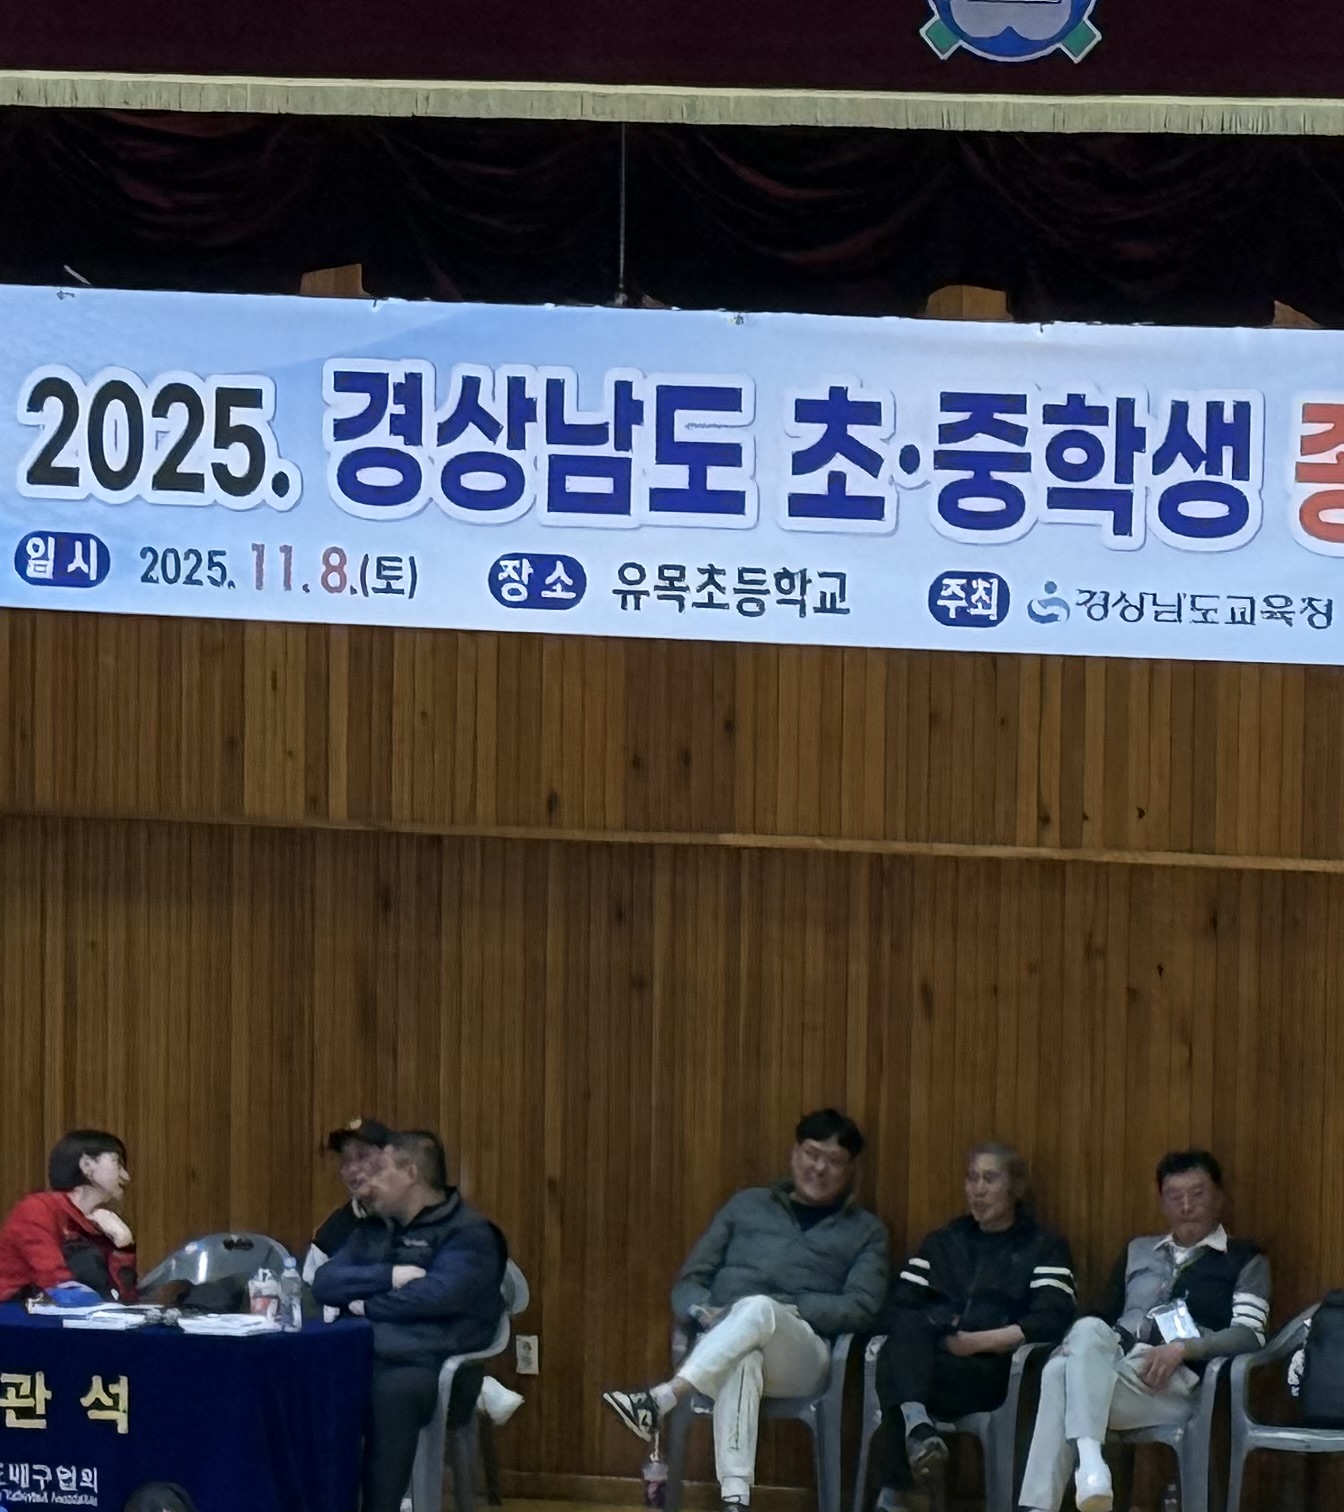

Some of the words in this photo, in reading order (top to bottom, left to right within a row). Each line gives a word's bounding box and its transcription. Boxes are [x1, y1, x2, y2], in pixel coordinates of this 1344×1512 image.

[26, 376, 291, 498] 2025.
[332, 370, 746, 516] 경상남도
[611, 561, 851, 618] 유목초등학교
[935, 576, 1000, 621] 주최
[1075, 587, 1335, 631] 경상남도교육청
